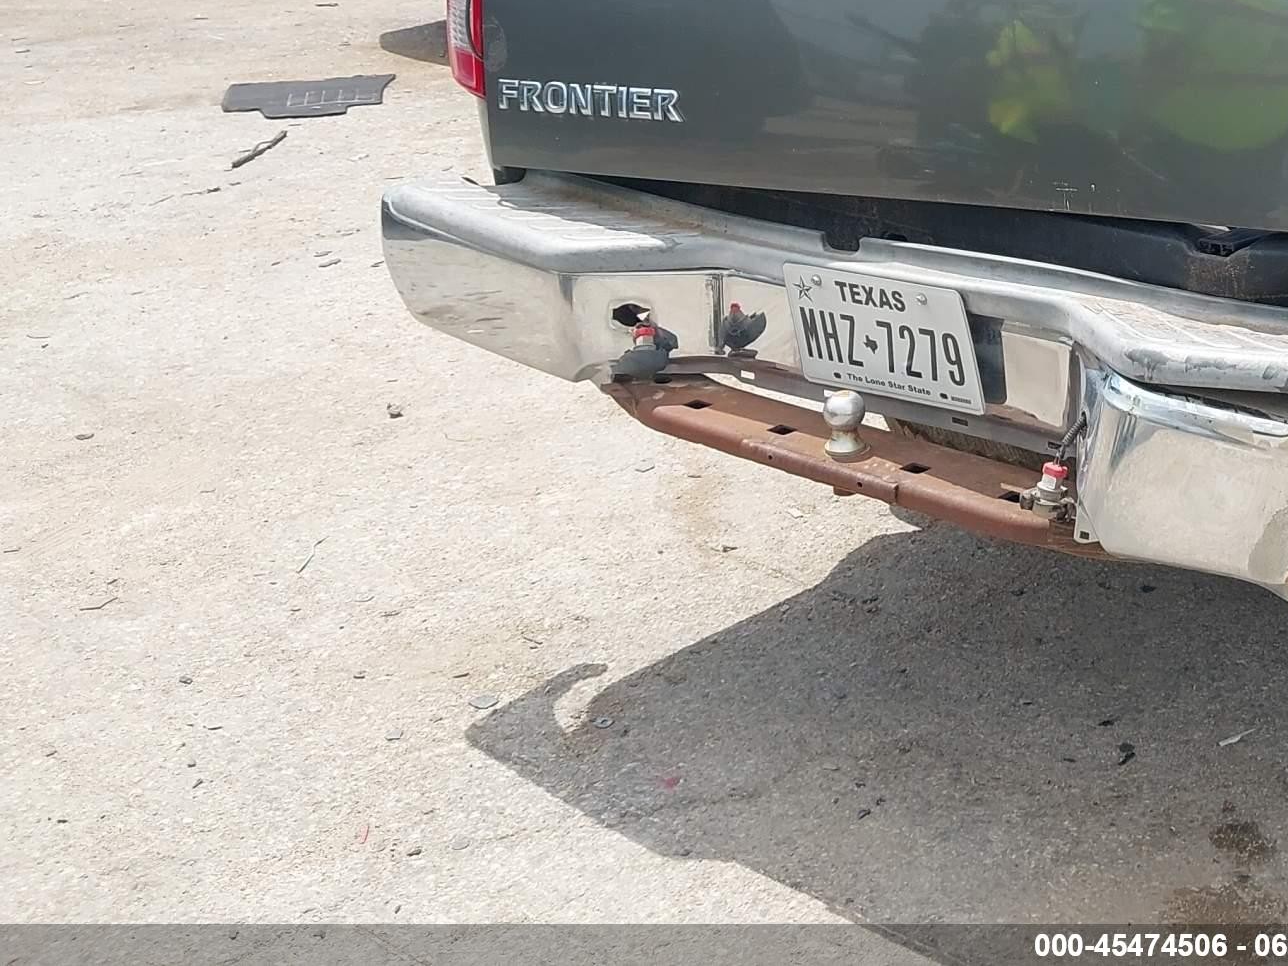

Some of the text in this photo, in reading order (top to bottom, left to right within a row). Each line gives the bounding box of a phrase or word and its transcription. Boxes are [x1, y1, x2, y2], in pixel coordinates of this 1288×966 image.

[498, 78, 685, 123] FRONTIER
[834, 280, 906, 312] TEXAS
[847, 372, 931, 396] The Lone Star State
